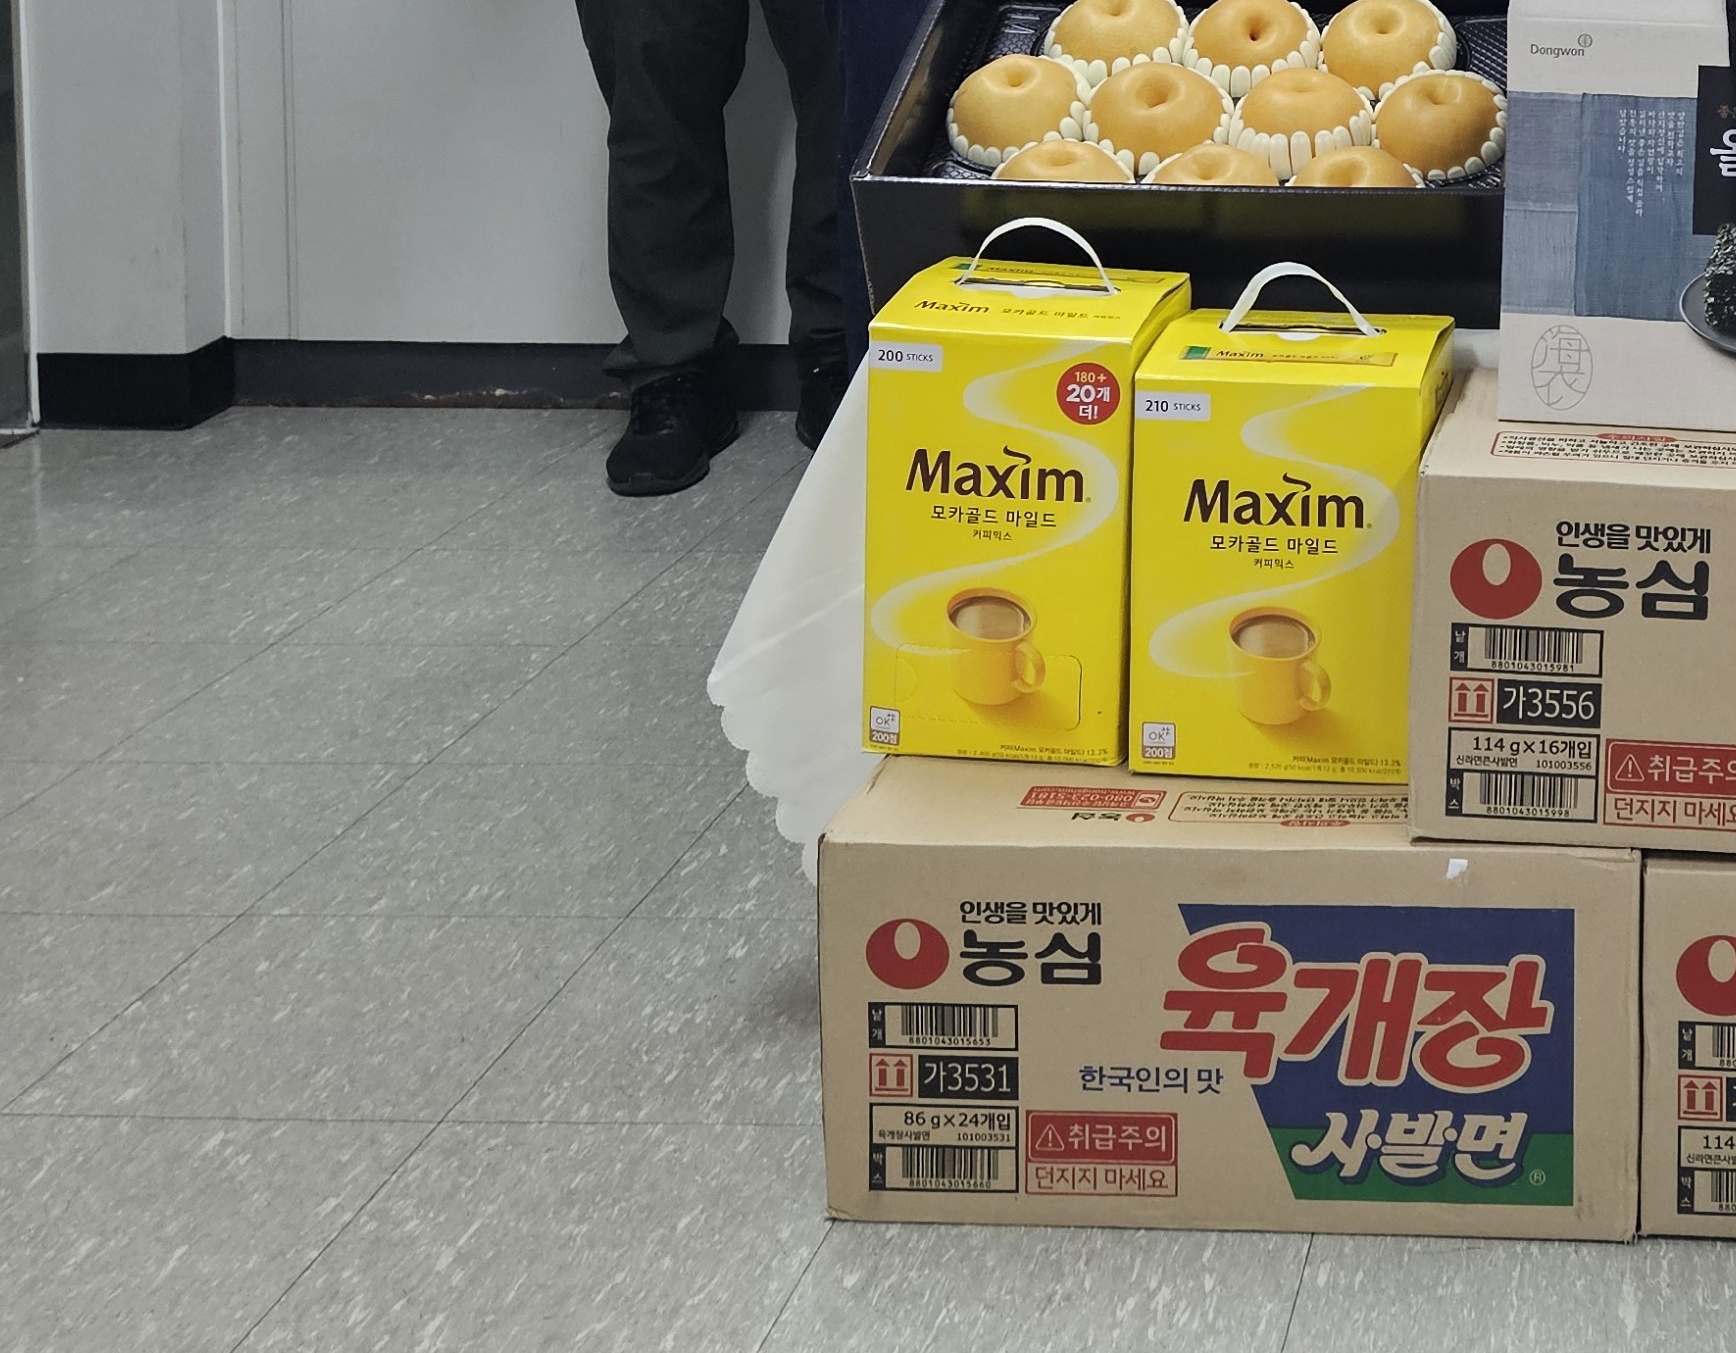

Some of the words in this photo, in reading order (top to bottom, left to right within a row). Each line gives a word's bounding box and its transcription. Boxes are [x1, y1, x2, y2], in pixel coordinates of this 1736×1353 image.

[1530, 44, 1585, 58] Dongwon
[914, 300, 990, 314] Maxim
[878, 350, 903, 363] 200
[906, 353, 934, 363] STICKS
[1216, 349, 1264, 359] Maxim
[1066, 384, 1110, 403] 20개
[1079, 405, 1098, 420] 더!
[1145, 399, 1169, 413] 210
[1173, 402, 1201, 412] STICKS
[905, 445, 1085, 504] Maxim
[1184, 472, 1366, 529] Maxim
[931, 505, 998, 525] 모카골드
[1006, 509, 1057, 528] 마일드
[972, 529, 1013, 542] 커피믹스
[1556, 522, 1630, 550] 인생을
[1635, 524, 1711, 554] 맛있게
[1210, 535, 1279, 554] 모카골드
[1286, 536, 1338, 556] 마일드
[1253, 557, 1294, 570] 커피믹스
[1553, 553, 1710, 621] 농심
[1491, 660, 1575, 673] 8801043015981
[1503, 685, 1595, 720] 가3556
[1472, 736, 1505, 753] 114
[1536, 759, 1592, 771] 101003556
[1486, 806, 1570, 818] 8801043015998
[1614, 798, 1677, 824] 던지지
[959, 900, 1027, 926] 인생을
[1030, 901, 1102, 927] 맛있게
[959, 929, 1102, 987] 농심
[1159, 925, 1552, 1091] 육개장
[909, 1036, 991, 1046] 8801043015653
[924, 1061, 1011, 1094] 가3531
[1079, 1065, 1188, 1094] 한국인의
[1197, 1067, 1223, 1095] 맛
[904, 1111, 926, 1127] 86
[957, 1132, 1011, 1142] 101003531
[1068, 1123, 1166, 1153] 취급주의
[1702, 1134, 1735, 1151] 114
[1291, 1110, 1528, 1184] 사발면
[909, 1179, 992, 1189] 8801043015660
[1035, 1167, 1098, 1190] 던지지
[1105, 1167, 1168, 1191] 마세요
